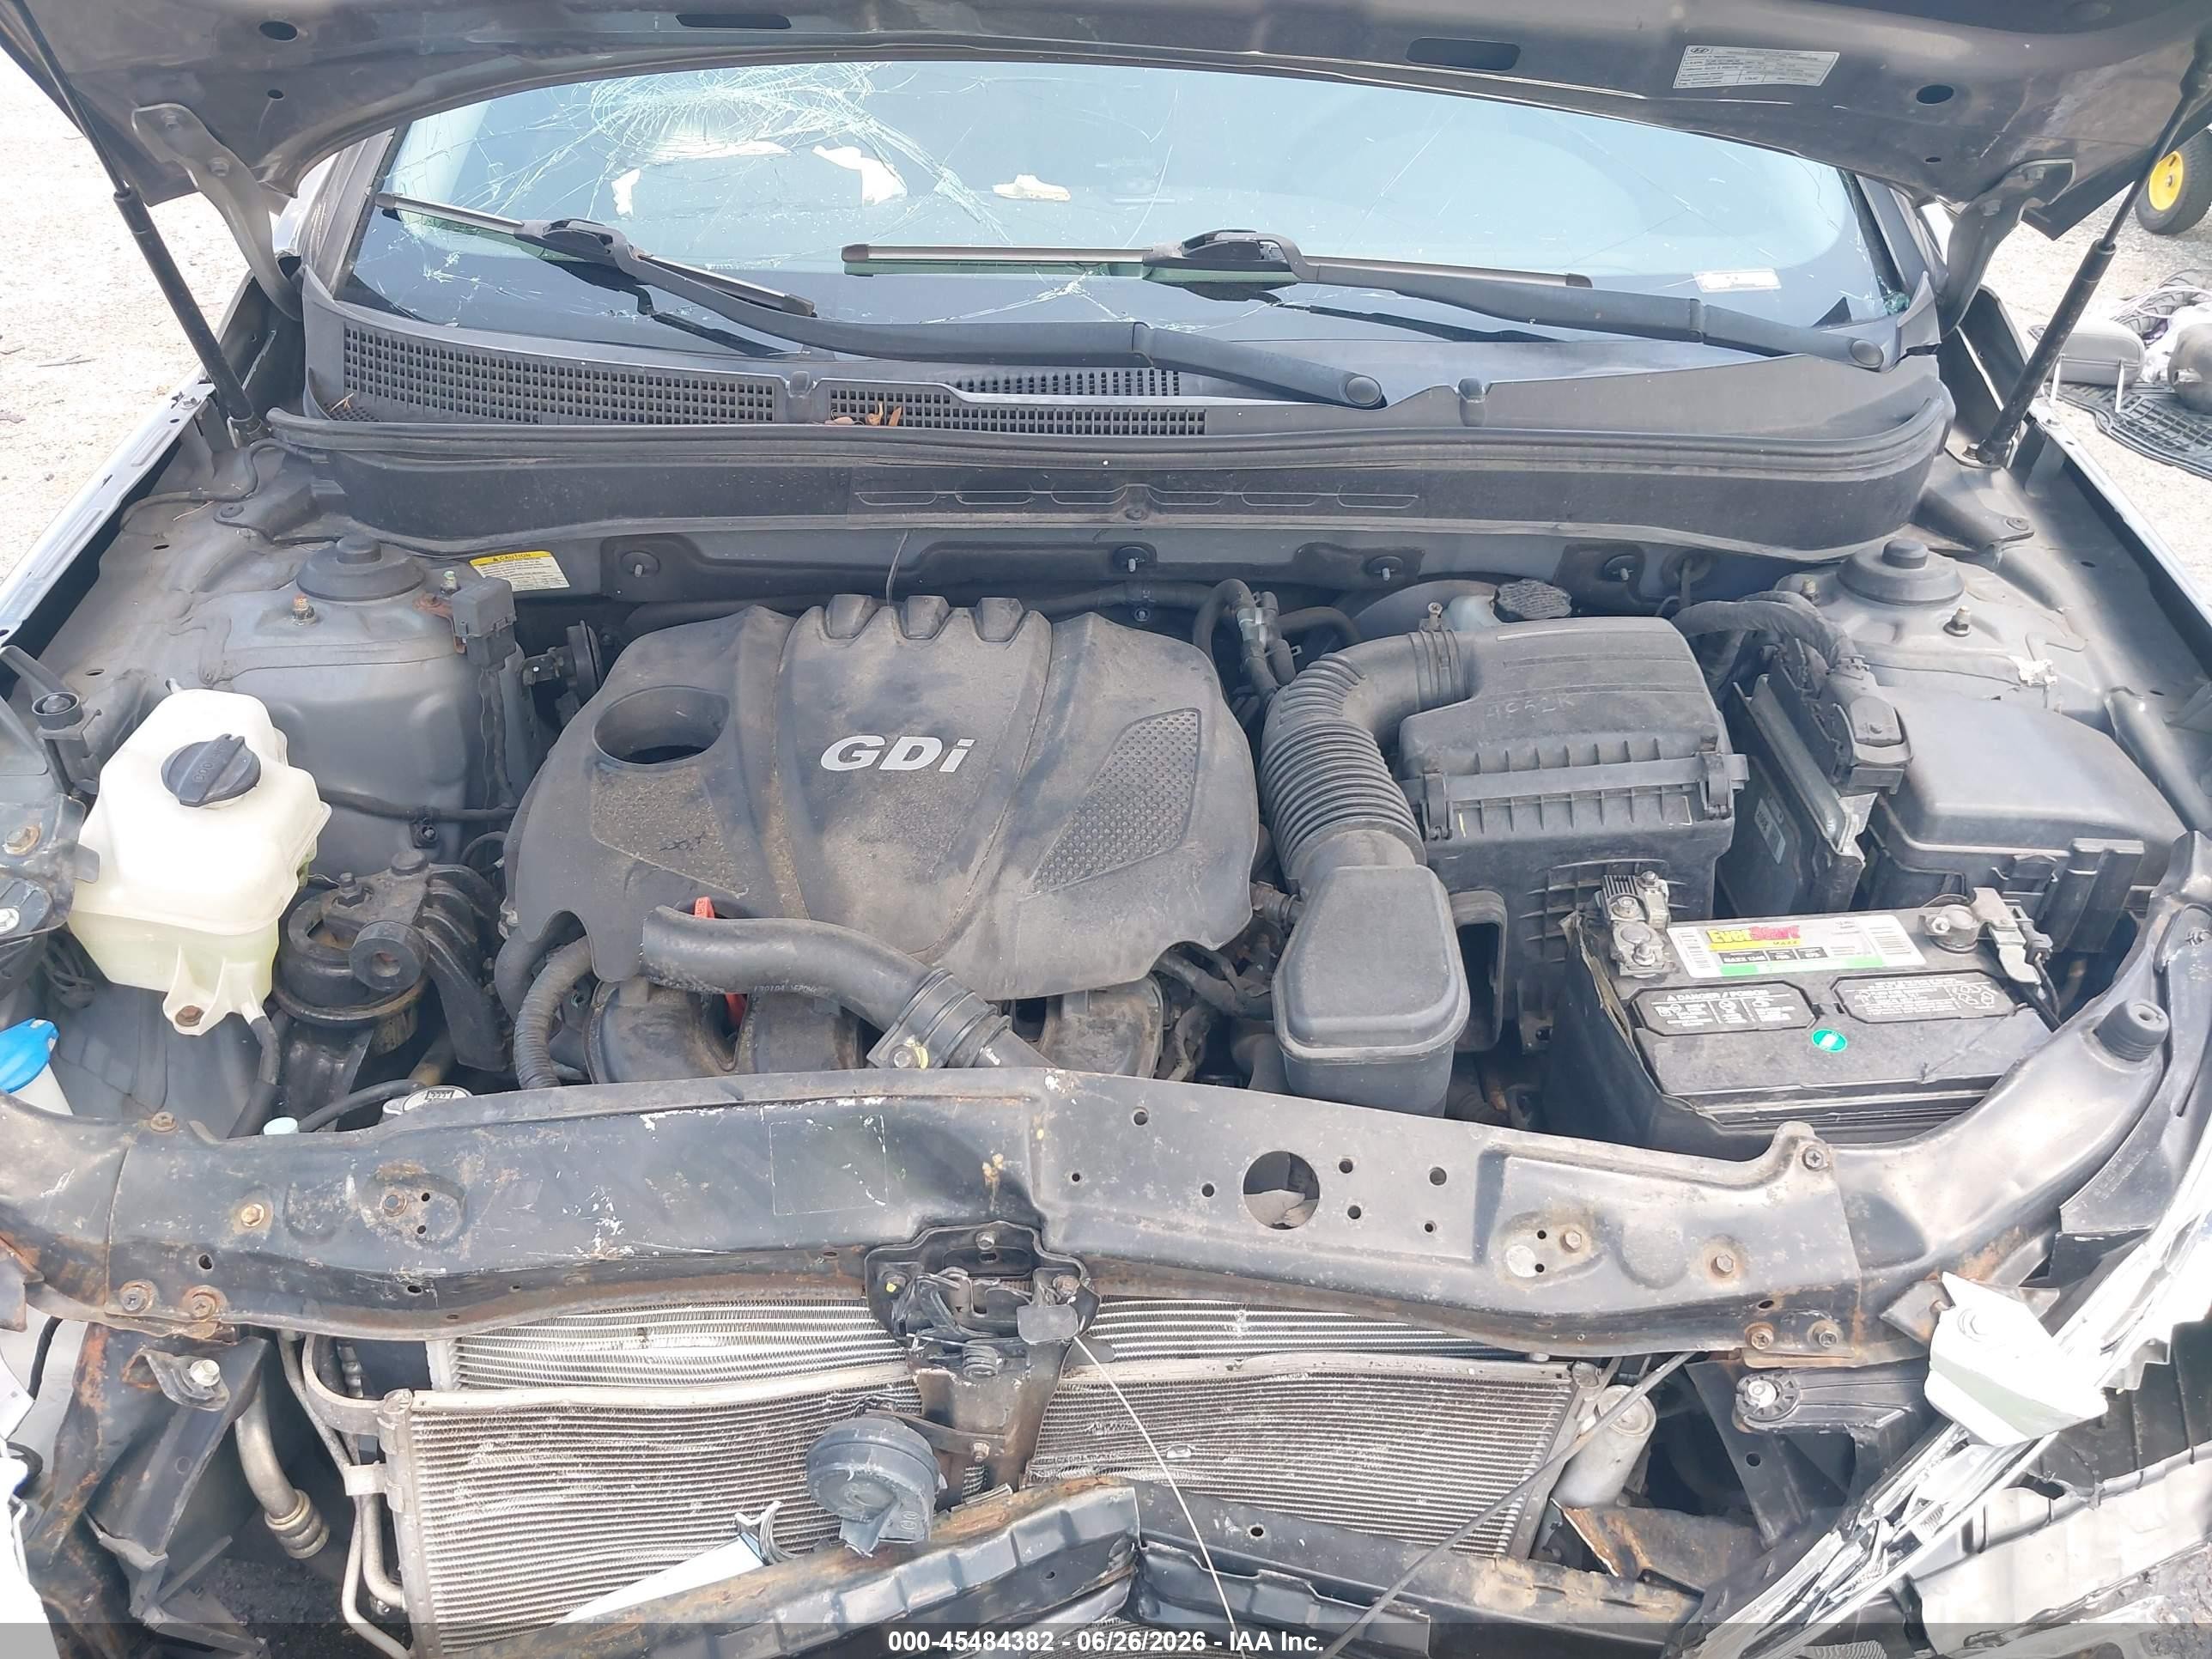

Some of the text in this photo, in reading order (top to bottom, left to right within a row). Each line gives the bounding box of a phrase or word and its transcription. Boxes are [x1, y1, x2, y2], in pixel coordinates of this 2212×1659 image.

[821, 735, 975, 773] GDi
[1677, 992, 1720, 1001] DANGER
[1730, 989, 1770, 998] POISON
